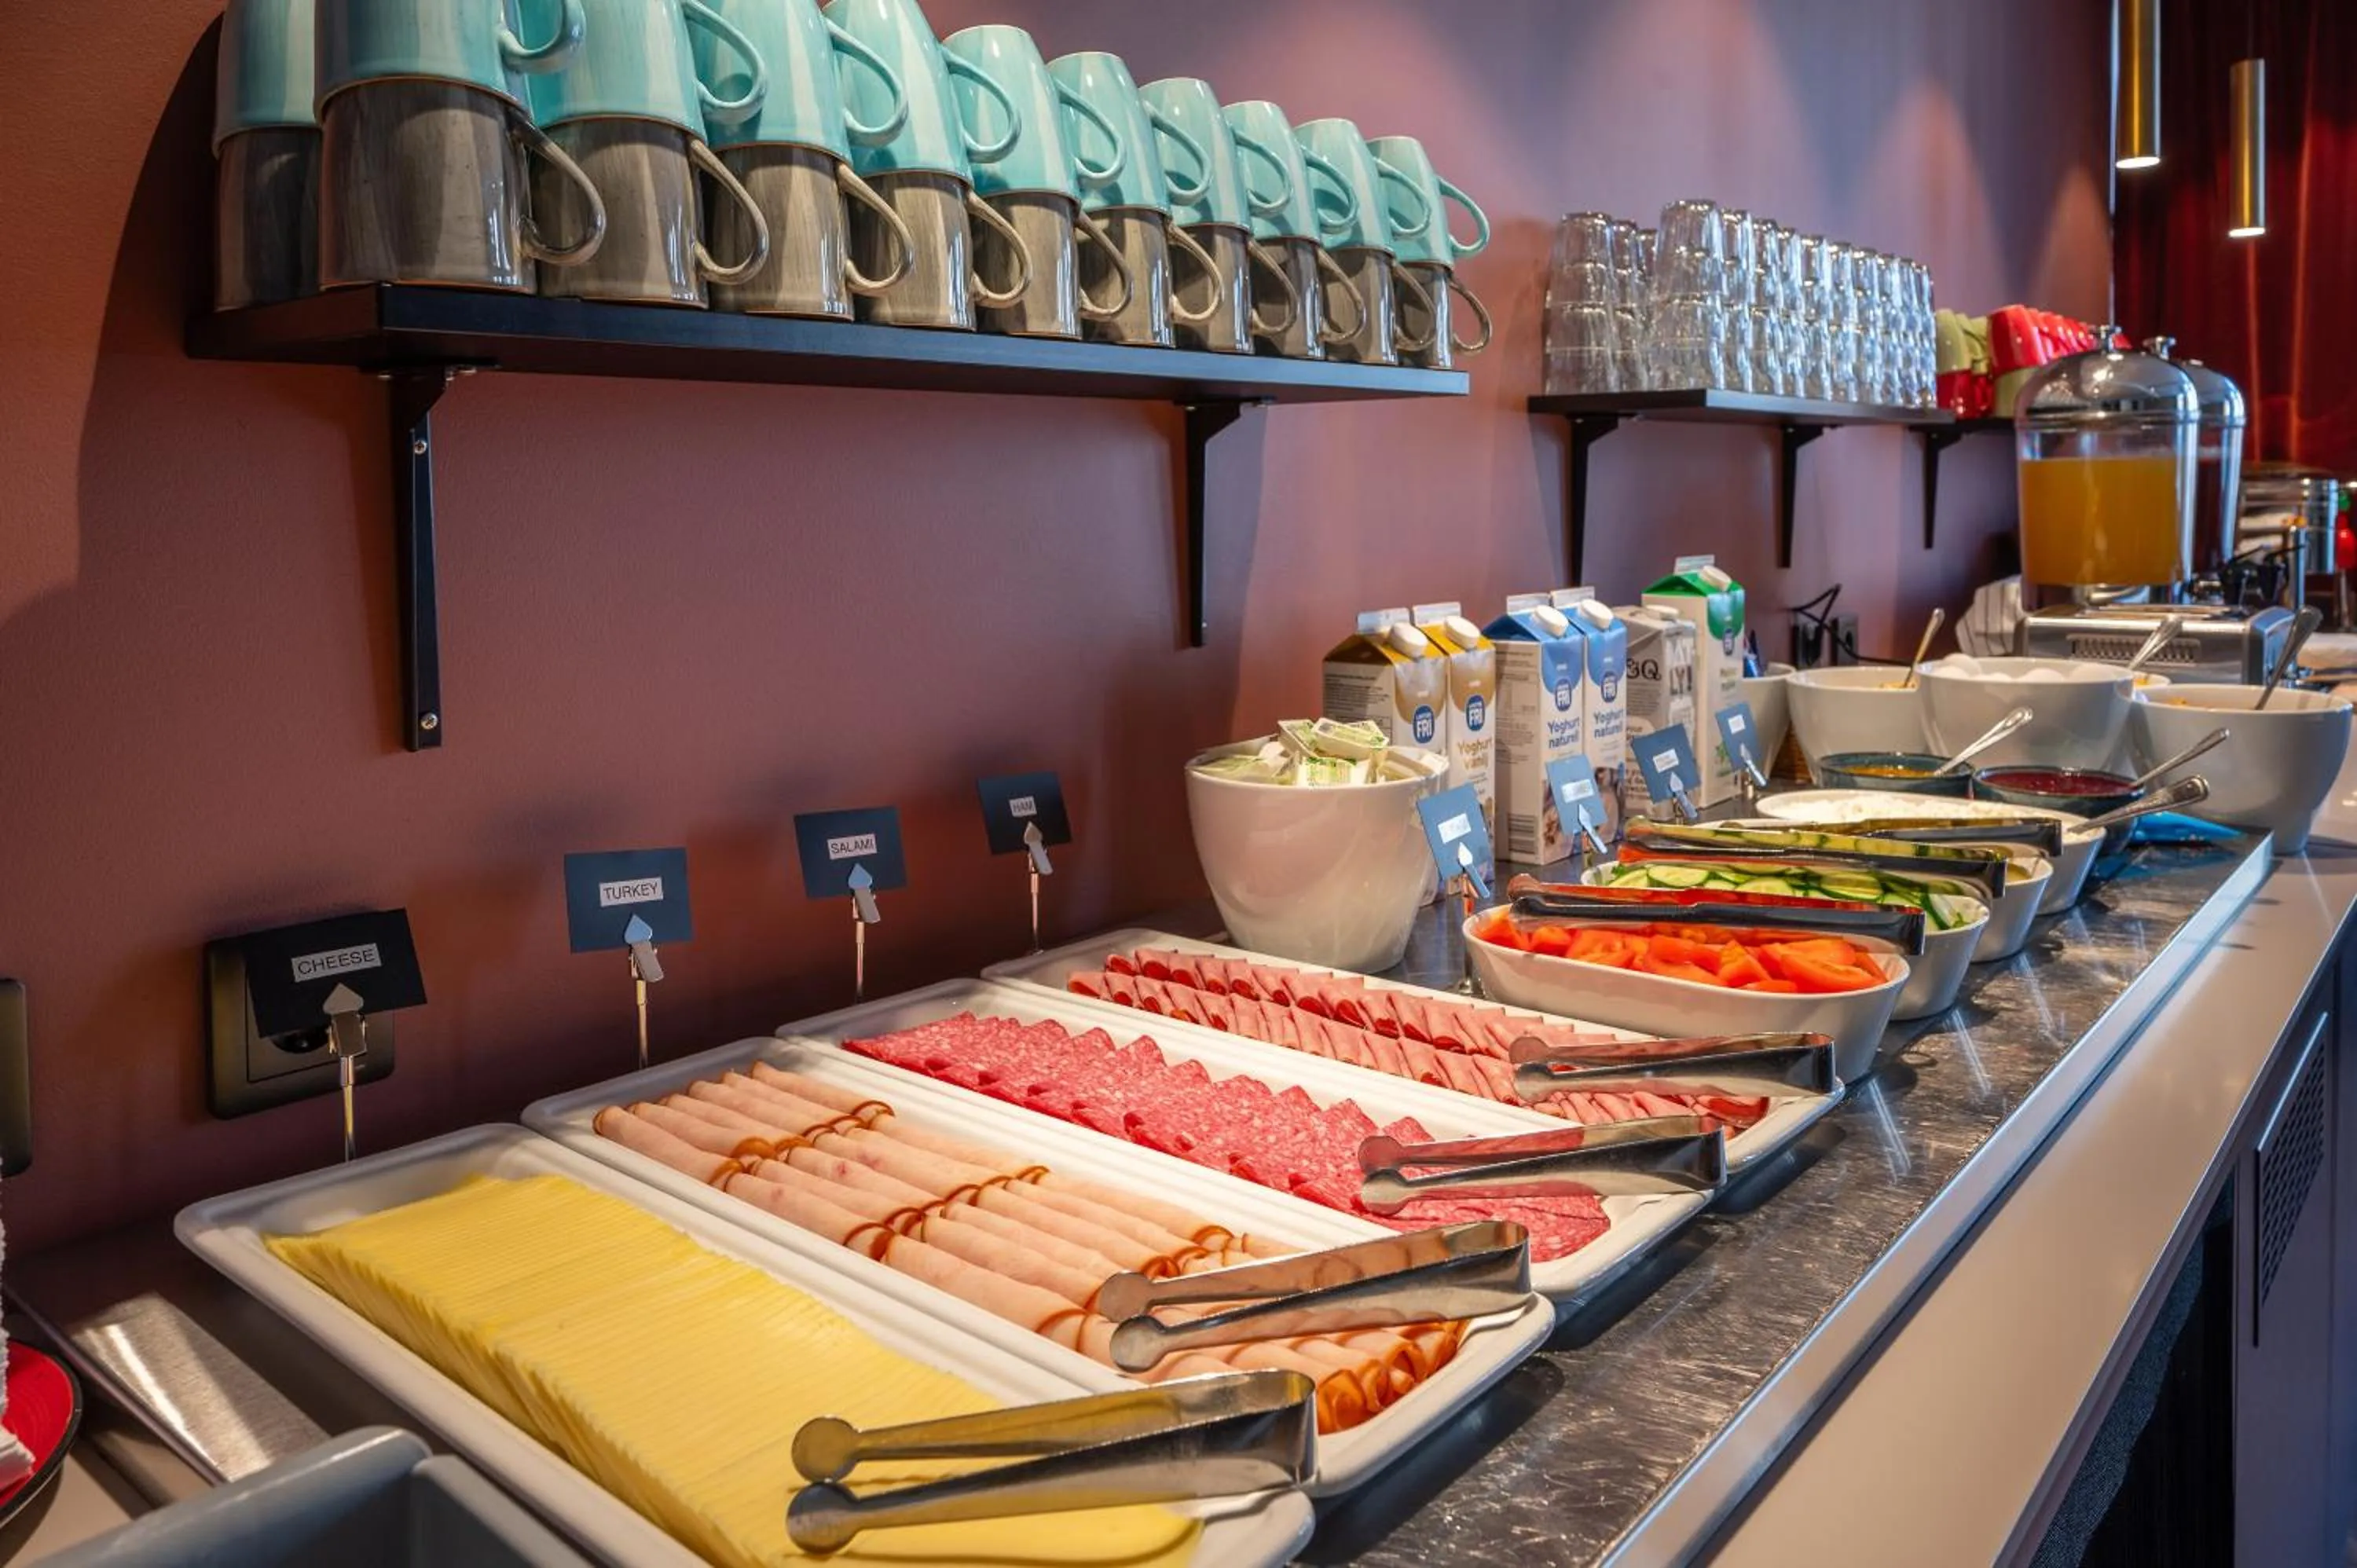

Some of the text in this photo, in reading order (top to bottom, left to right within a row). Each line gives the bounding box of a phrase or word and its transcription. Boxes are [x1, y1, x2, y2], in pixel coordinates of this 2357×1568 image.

[1468, 707, 1484, 726] FRI
[1416, 719, 1432, 738] FRI
[830, 837, 874, 854] SALAMI
[603, 881, 658, 900] TURKEY
[298, 948, 376, 975] CHEESE
